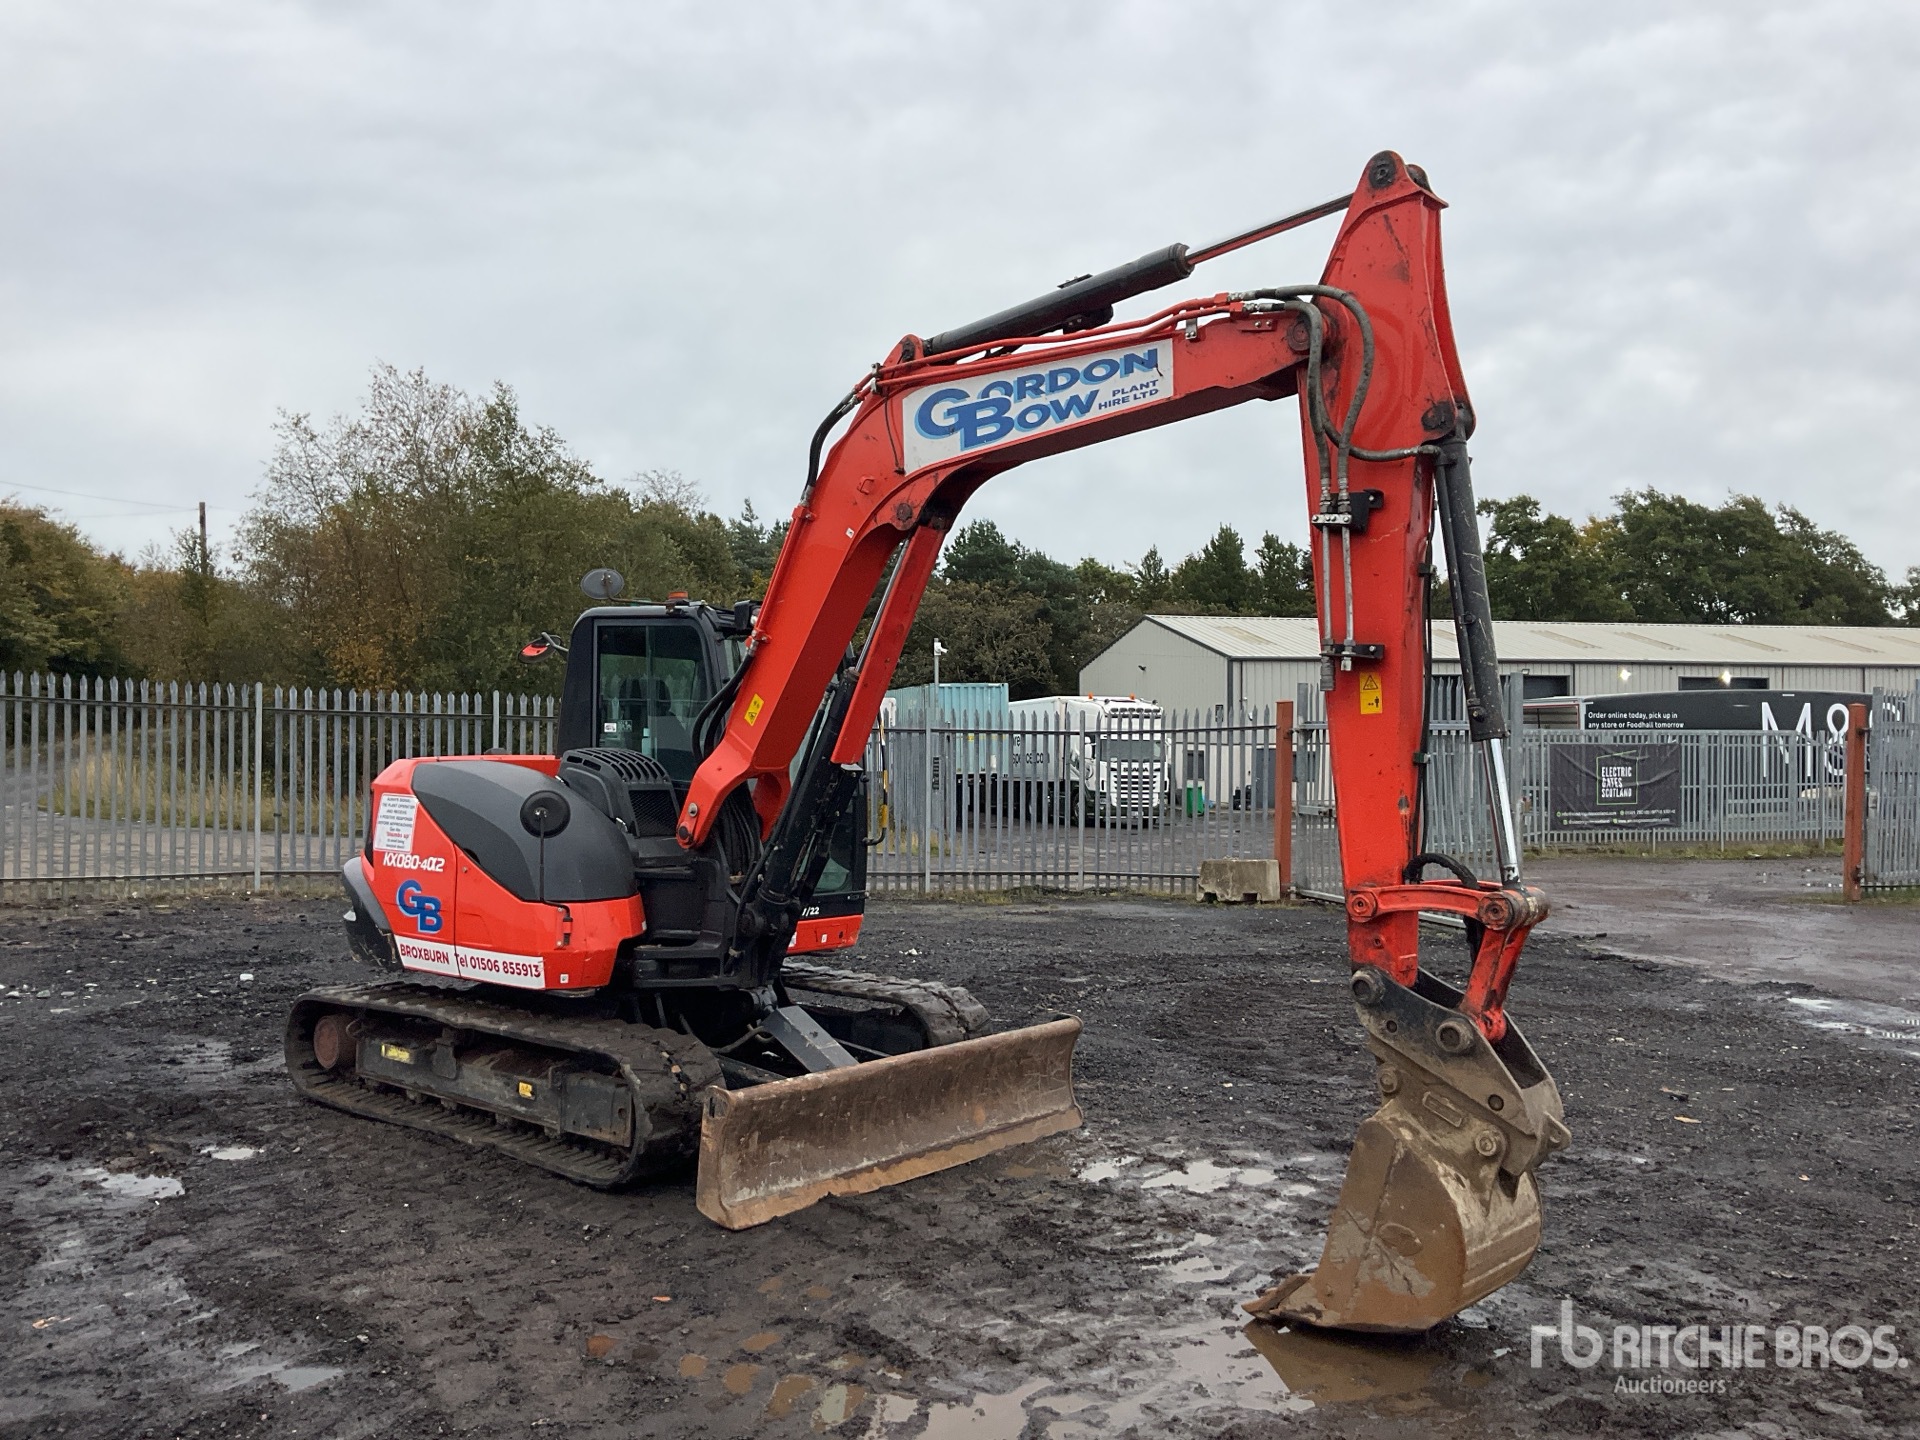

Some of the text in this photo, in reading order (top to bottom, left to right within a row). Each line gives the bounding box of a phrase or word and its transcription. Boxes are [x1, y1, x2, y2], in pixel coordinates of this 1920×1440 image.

[915, 348, 1158, 439] GORDON
[1112, 380, 1158, 397] PLANT
[1098, 388, 1159, 410] HIRE LTD
[960, 390, 1099, 451] BOW
[1588, 711, 1606, 719] Order
[1607, 711, 1627, 719] online
[1628, 711, 1648, 720] today,
[1648, 711, 1661, 720] pick
[1671, 711, 1678, 719] in
[1601, 766, 1632, 777] ELECTRIC
[1601, 777, 1623, 788] GATES
[1601, 788, 1632, 798] SCOTLAND
[396, 879, 443, 934] GB
[400, 943, 541, 978] BROXBURN Tel 01506 855913
